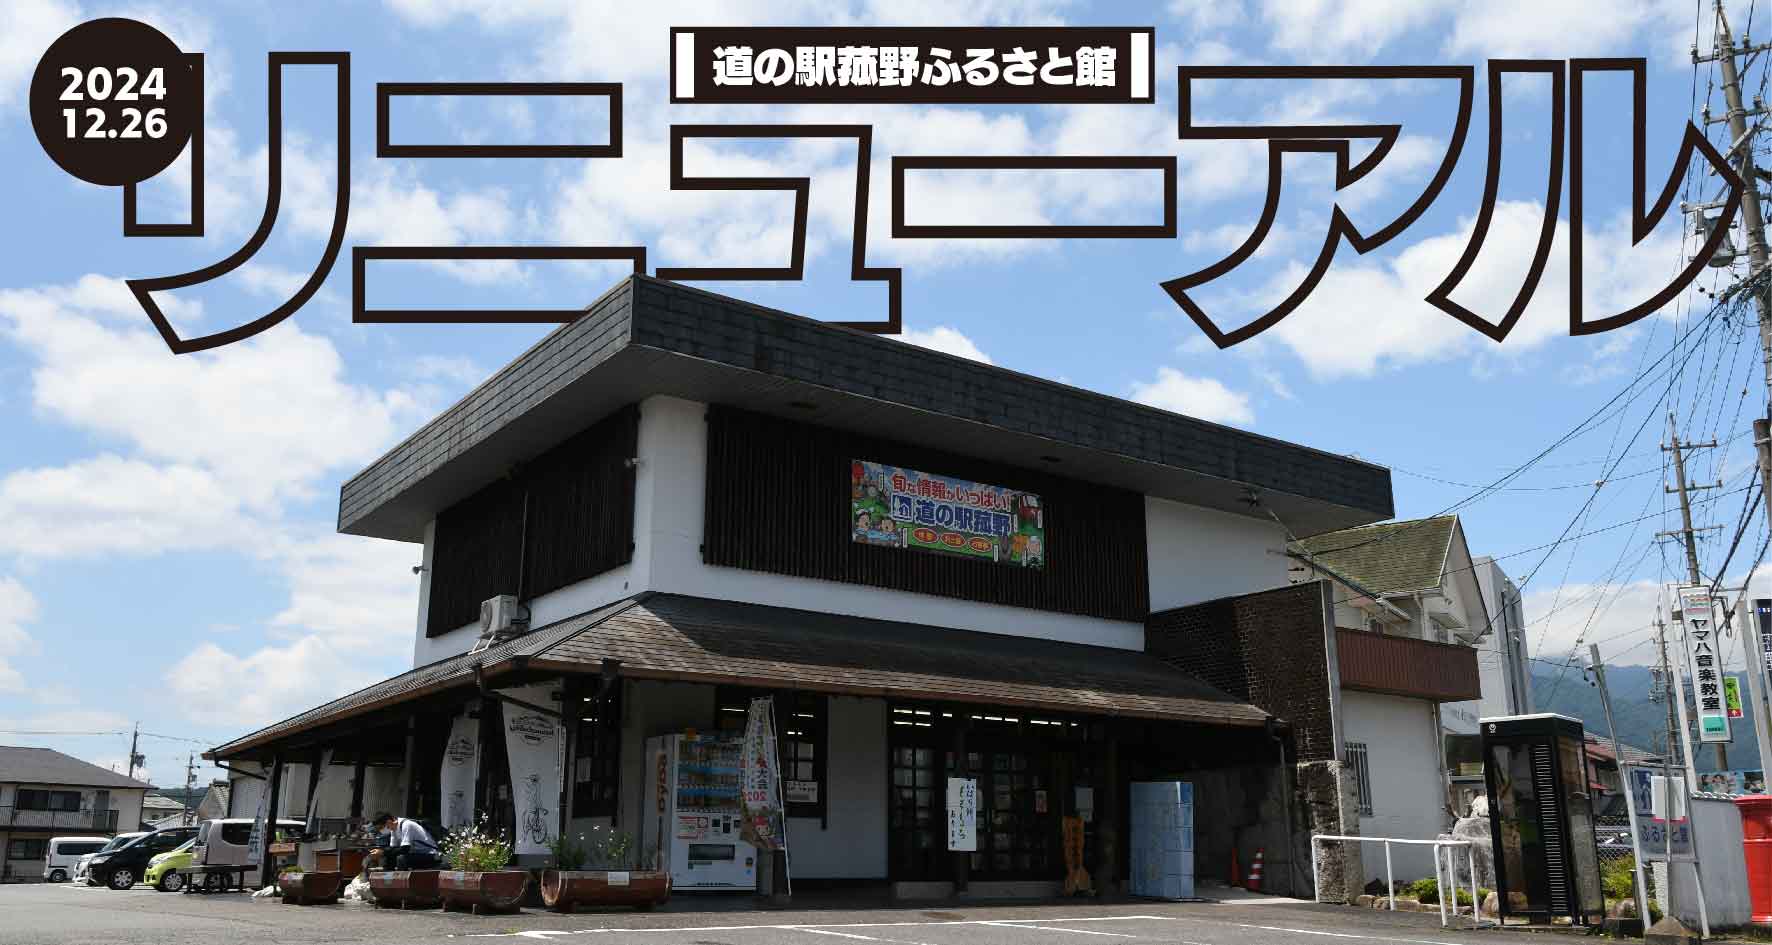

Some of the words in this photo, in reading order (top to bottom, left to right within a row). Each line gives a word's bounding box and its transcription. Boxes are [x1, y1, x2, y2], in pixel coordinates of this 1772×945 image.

[1690, 619, 1721, 711] ヤマハ音楽教室
